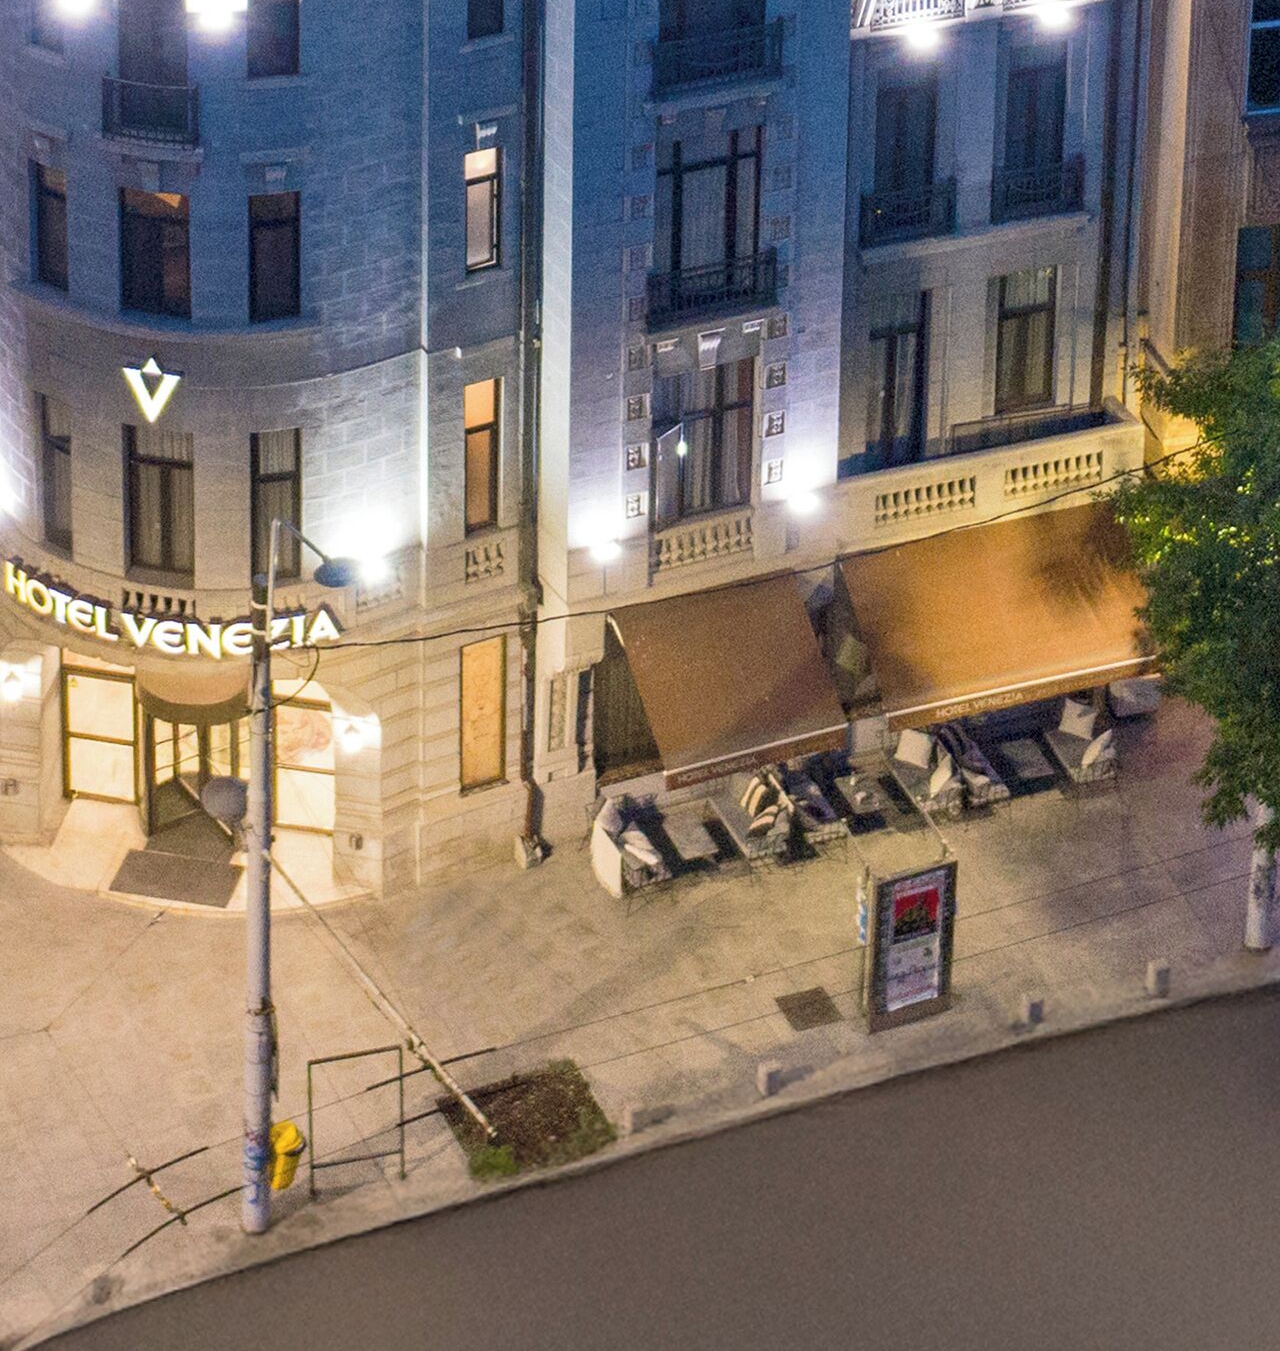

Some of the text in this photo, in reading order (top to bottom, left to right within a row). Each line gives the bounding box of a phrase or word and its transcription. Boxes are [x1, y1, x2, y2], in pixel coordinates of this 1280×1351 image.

[5, 560, 341, 660] HOTEL VENEZIA
[935, 692, 1024, 718] HOTEL VENEZIA
